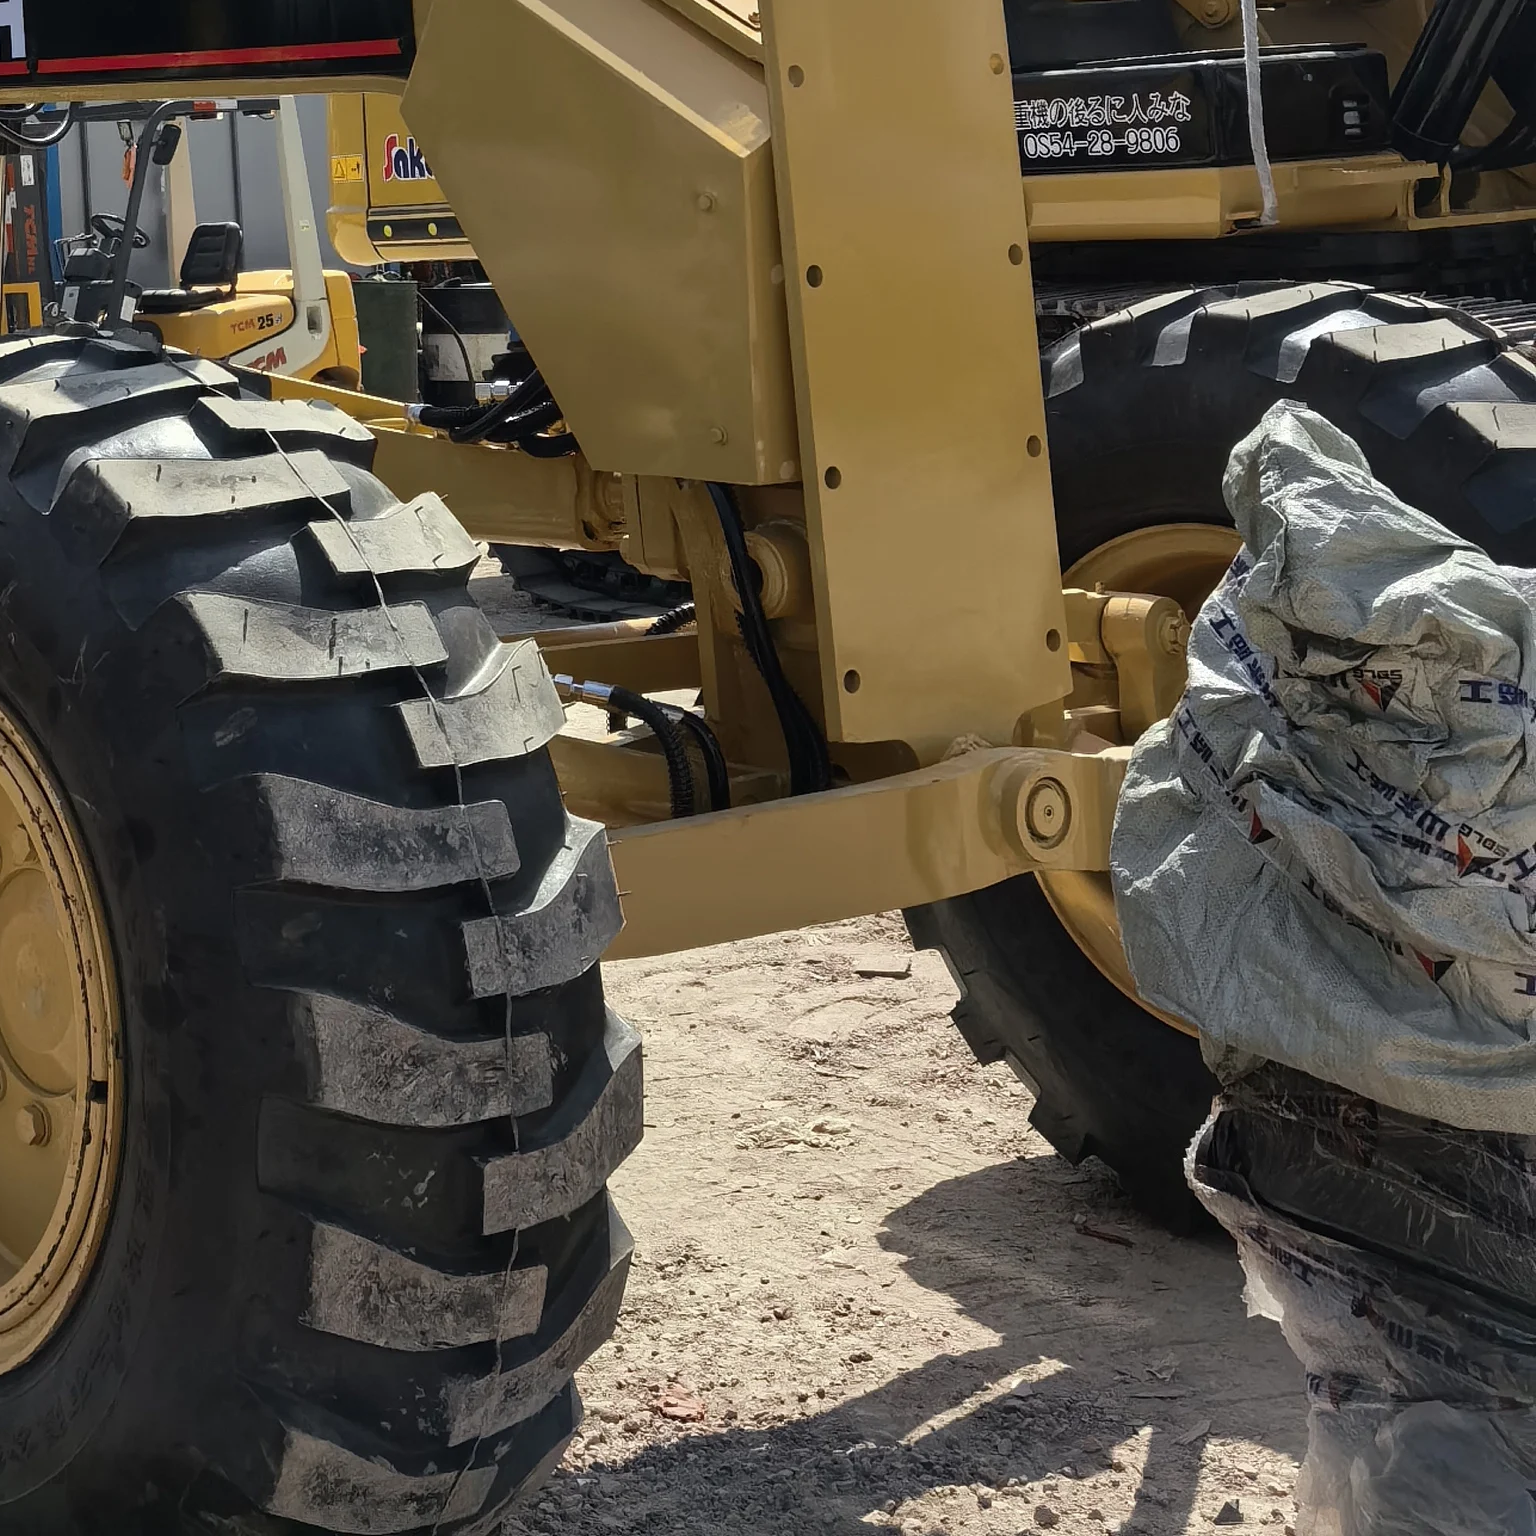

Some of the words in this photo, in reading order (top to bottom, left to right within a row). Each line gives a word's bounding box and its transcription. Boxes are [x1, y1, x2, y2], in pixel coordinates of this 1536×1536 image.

[383, 133, 435, 182] Sak
[230, 318, 256, 335] TCM
[257, 312, 274, 331] 25
[246, 347, 287, 372] CM
